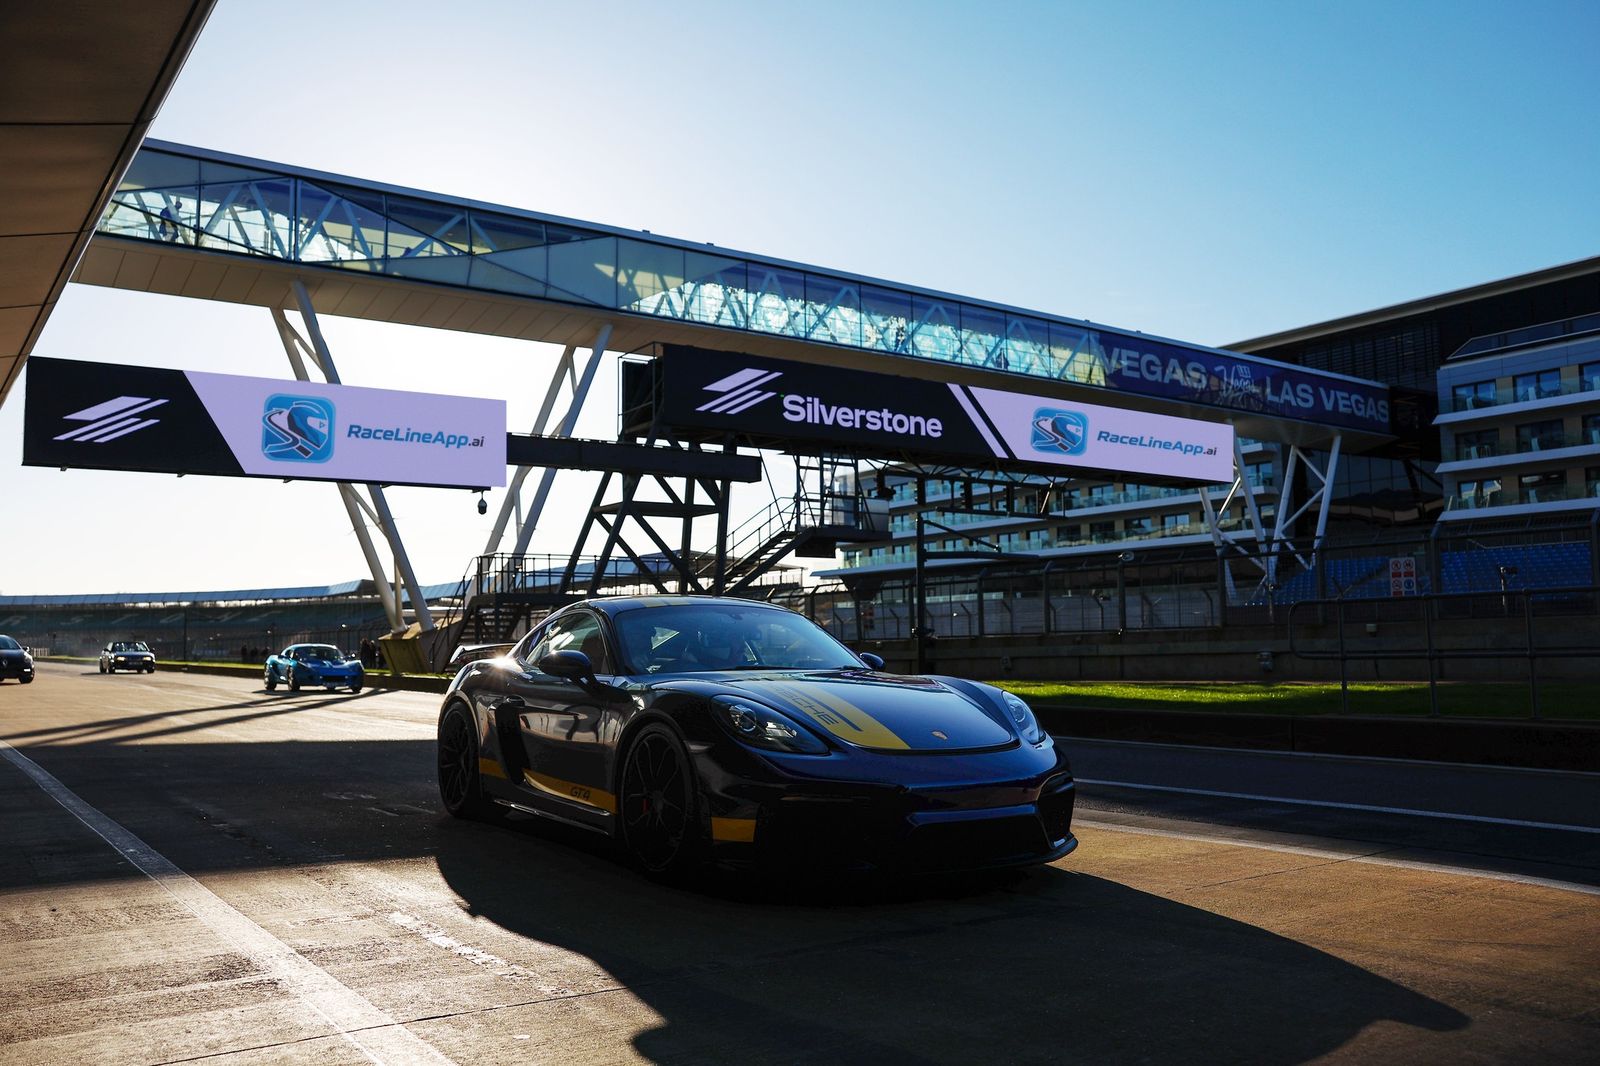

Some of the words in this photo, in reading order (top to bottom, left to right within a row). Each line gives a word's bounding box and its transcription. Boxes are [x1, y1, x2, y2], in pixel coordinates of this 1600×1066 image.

[1099, 346, 1209, 391] VEGAS
[782, 394, 943, 438] Silverstone
[1266, 376, 1315, 408] LAS
[1319, 387, 1389, 423] VEGAS
[347, 424, 485, 448] RaceLineApp.ai
[1097, 430, 1217, 456] RaceLineApp.ai
